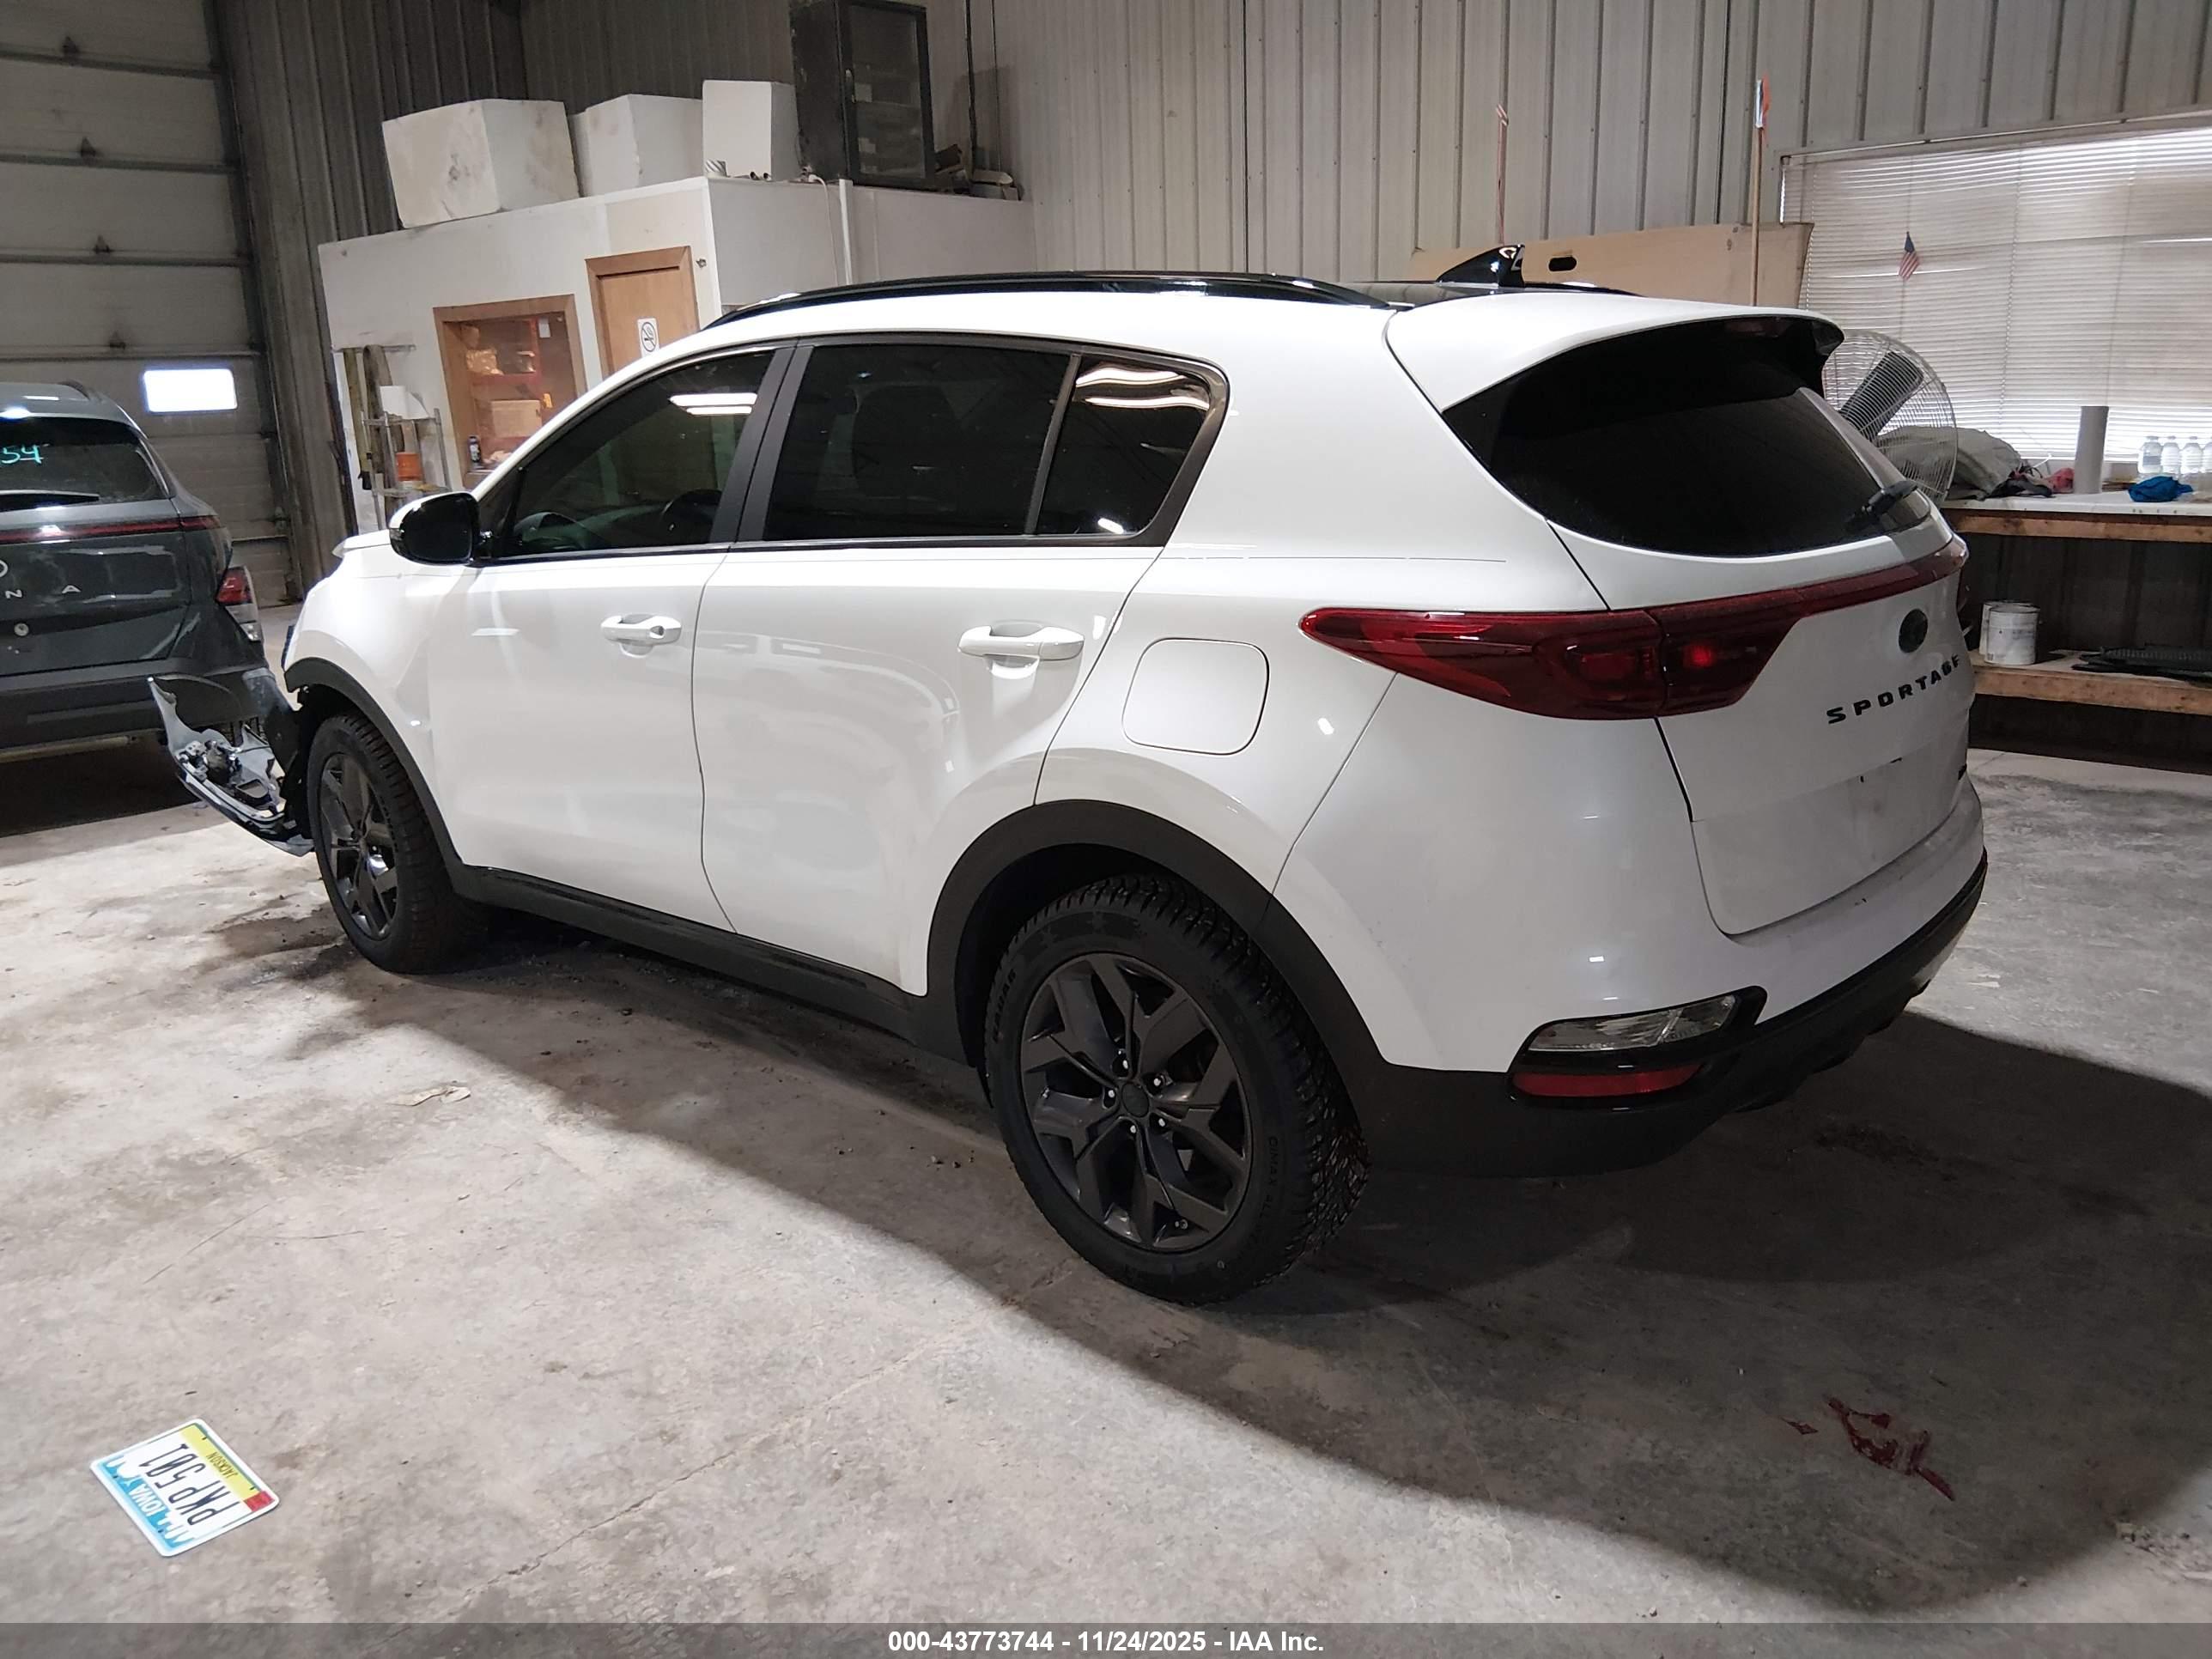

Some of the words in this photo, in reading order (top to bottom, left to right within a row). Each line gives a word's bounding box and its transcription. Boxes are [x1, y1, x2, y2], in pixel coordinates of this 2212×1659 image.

[1826, 654, 1960, 725] SPORTAGE
[205, 1451, 239, 1479] JACKSON
[130, 1483, 165, 1516] IOWA
[167, 1480, 241, 1525] PKP
